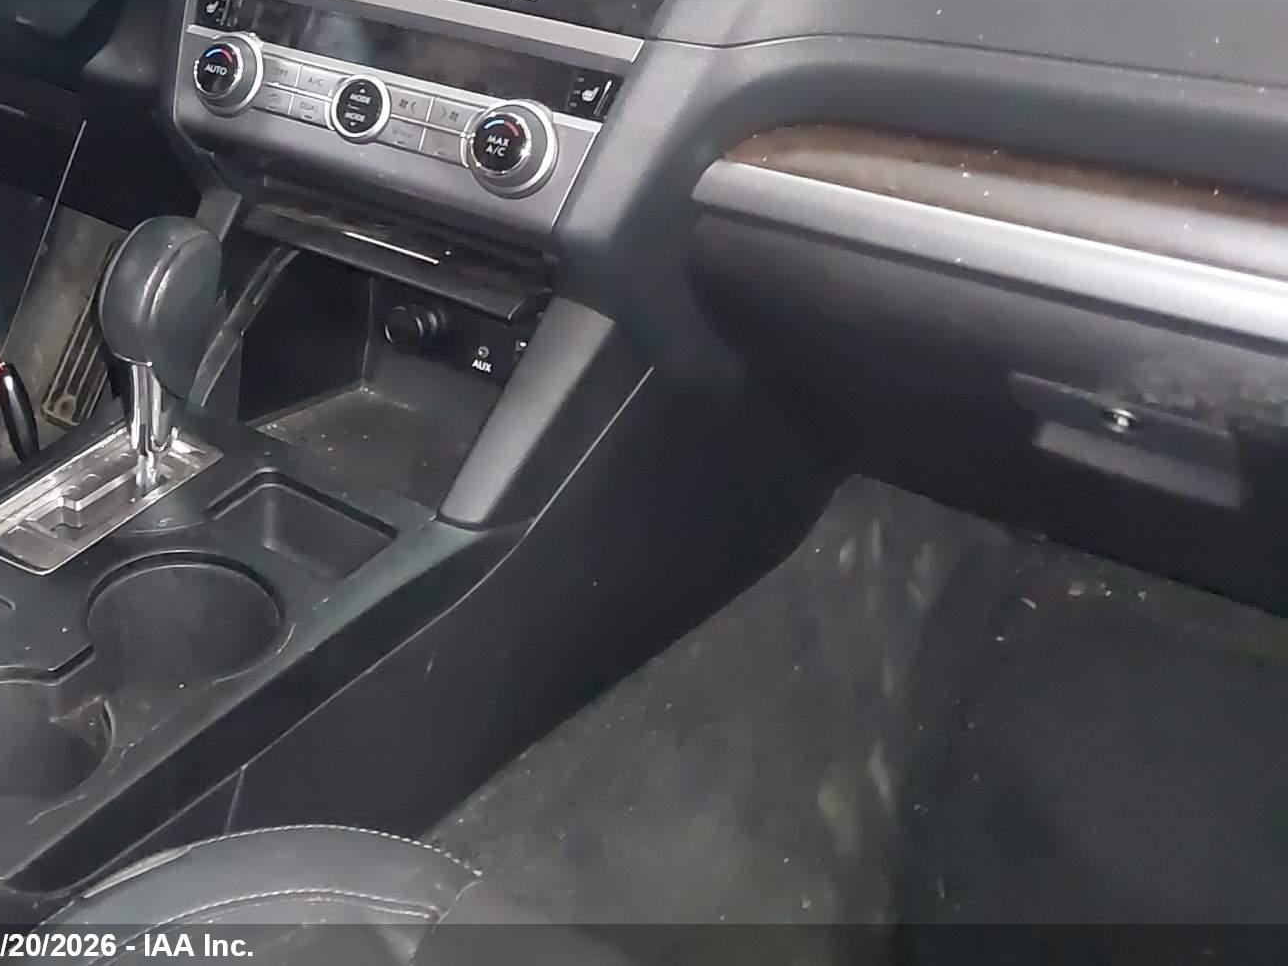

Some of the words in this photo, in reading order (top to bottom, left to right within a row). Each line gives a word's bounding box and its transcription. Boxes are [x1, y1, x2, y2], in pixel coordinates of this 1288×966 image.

[204, 63, 228, 76] AUTO
[349, 93, 372, 105] MODE
[345, 111, 366, 123] MODE
[486, 134, 511, 147] MAX
[485, 146, 507, 158] A/C
[471, 358, 493, 374] AUX
